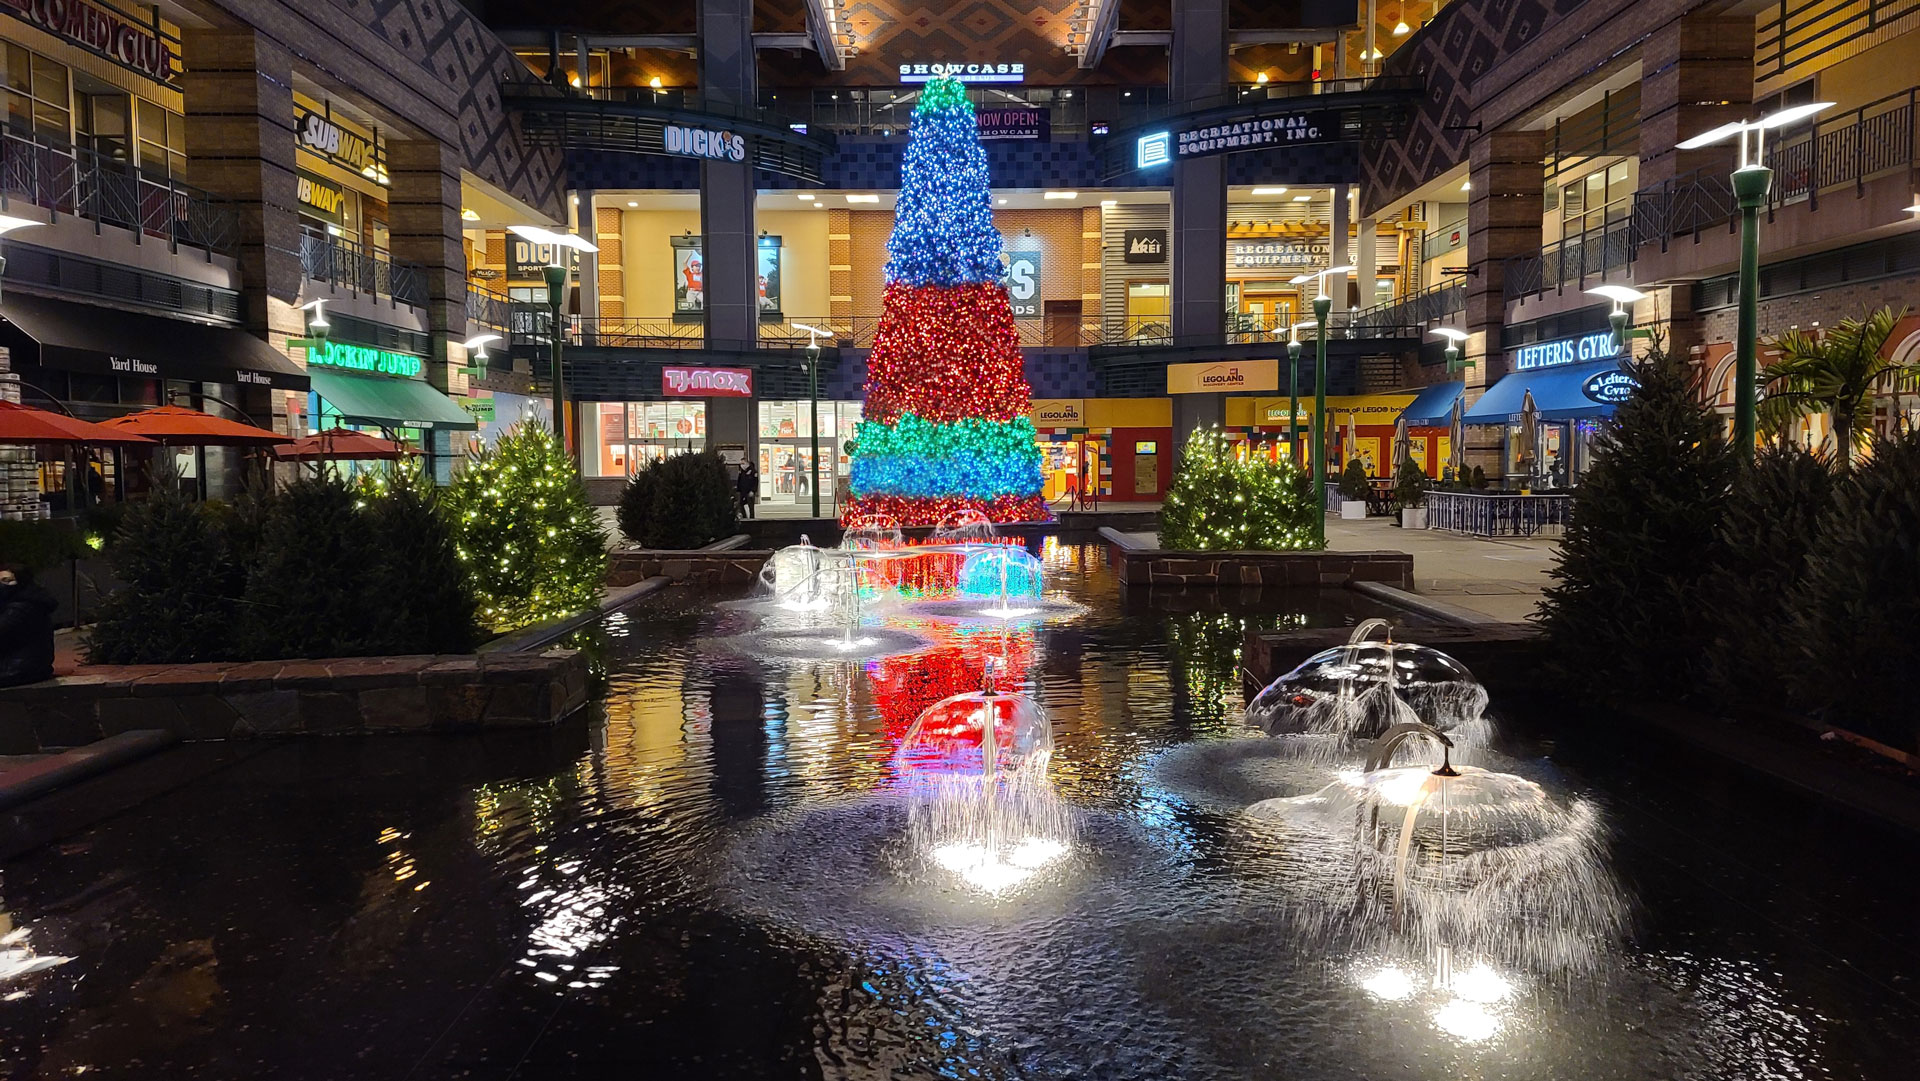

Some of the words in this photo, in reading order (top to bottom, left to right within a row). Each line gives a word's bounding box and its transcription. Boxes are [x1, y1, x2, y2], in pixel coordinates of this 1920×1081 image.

[29, 0, 118, 56] COMEDY
[118, 23, 171, 80] CLUB
[900, 64, 1024, 74] SHOWCASE
[976, 113, 1000, 126] NOW
[1004, 112, 1039, 126] OPEN!
[1179, 116, 1307, 142] RECREATIONAL
[302, 114, 377, 171] SUBWAY
[665, 126, 744, 161] DICK'S
[1179, 132, 1278, 154] EQUIPMENT,
[1286, 127, 1322, 140] INC.
[297, 175, 344, 213] BWAY
[1235, 245, 1329, 254] RECREATION
[110, 356, 130, 372] Yard
[133, 359, 157, 374] House
[378, 351, 421, 376] JUMP
[1517, 339, 1574, 370] LEFTERIS
[237, 370, 251, 383] Yard
[253, 373, 272, 385] House
[1203, 374, 1244, 383] LEGOLAND
[1268, 409, 1307, 417] LEGOLND
